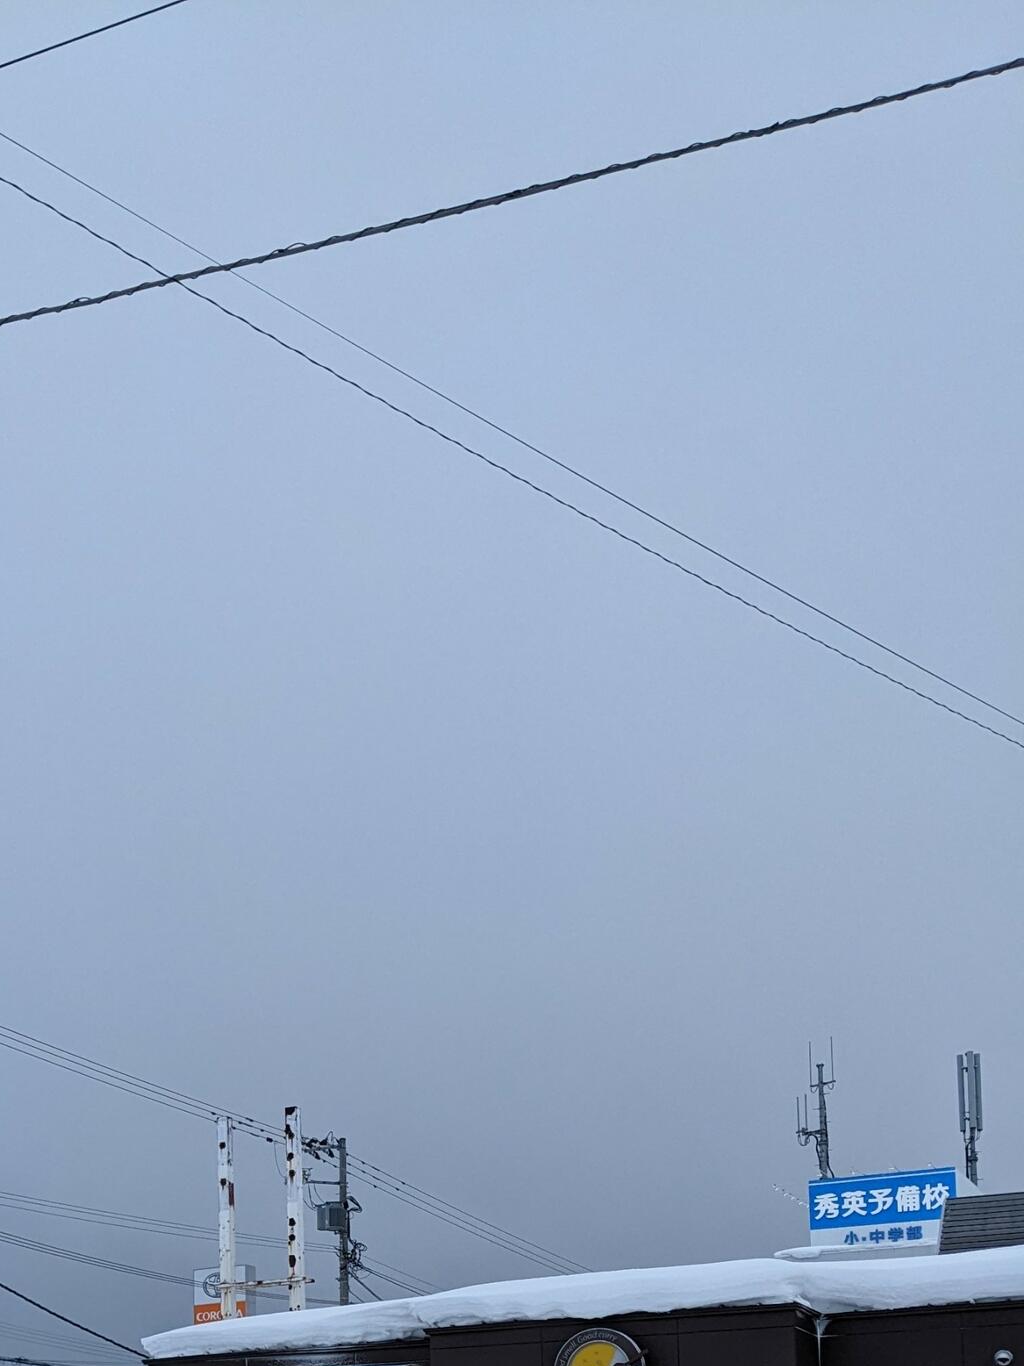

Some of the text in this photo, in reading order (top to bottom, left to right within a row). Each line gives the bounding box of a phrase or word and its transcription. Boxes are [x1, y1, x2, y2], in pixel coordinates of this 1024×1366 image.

[814, 1183, 950, 1220] 秀英予備校
